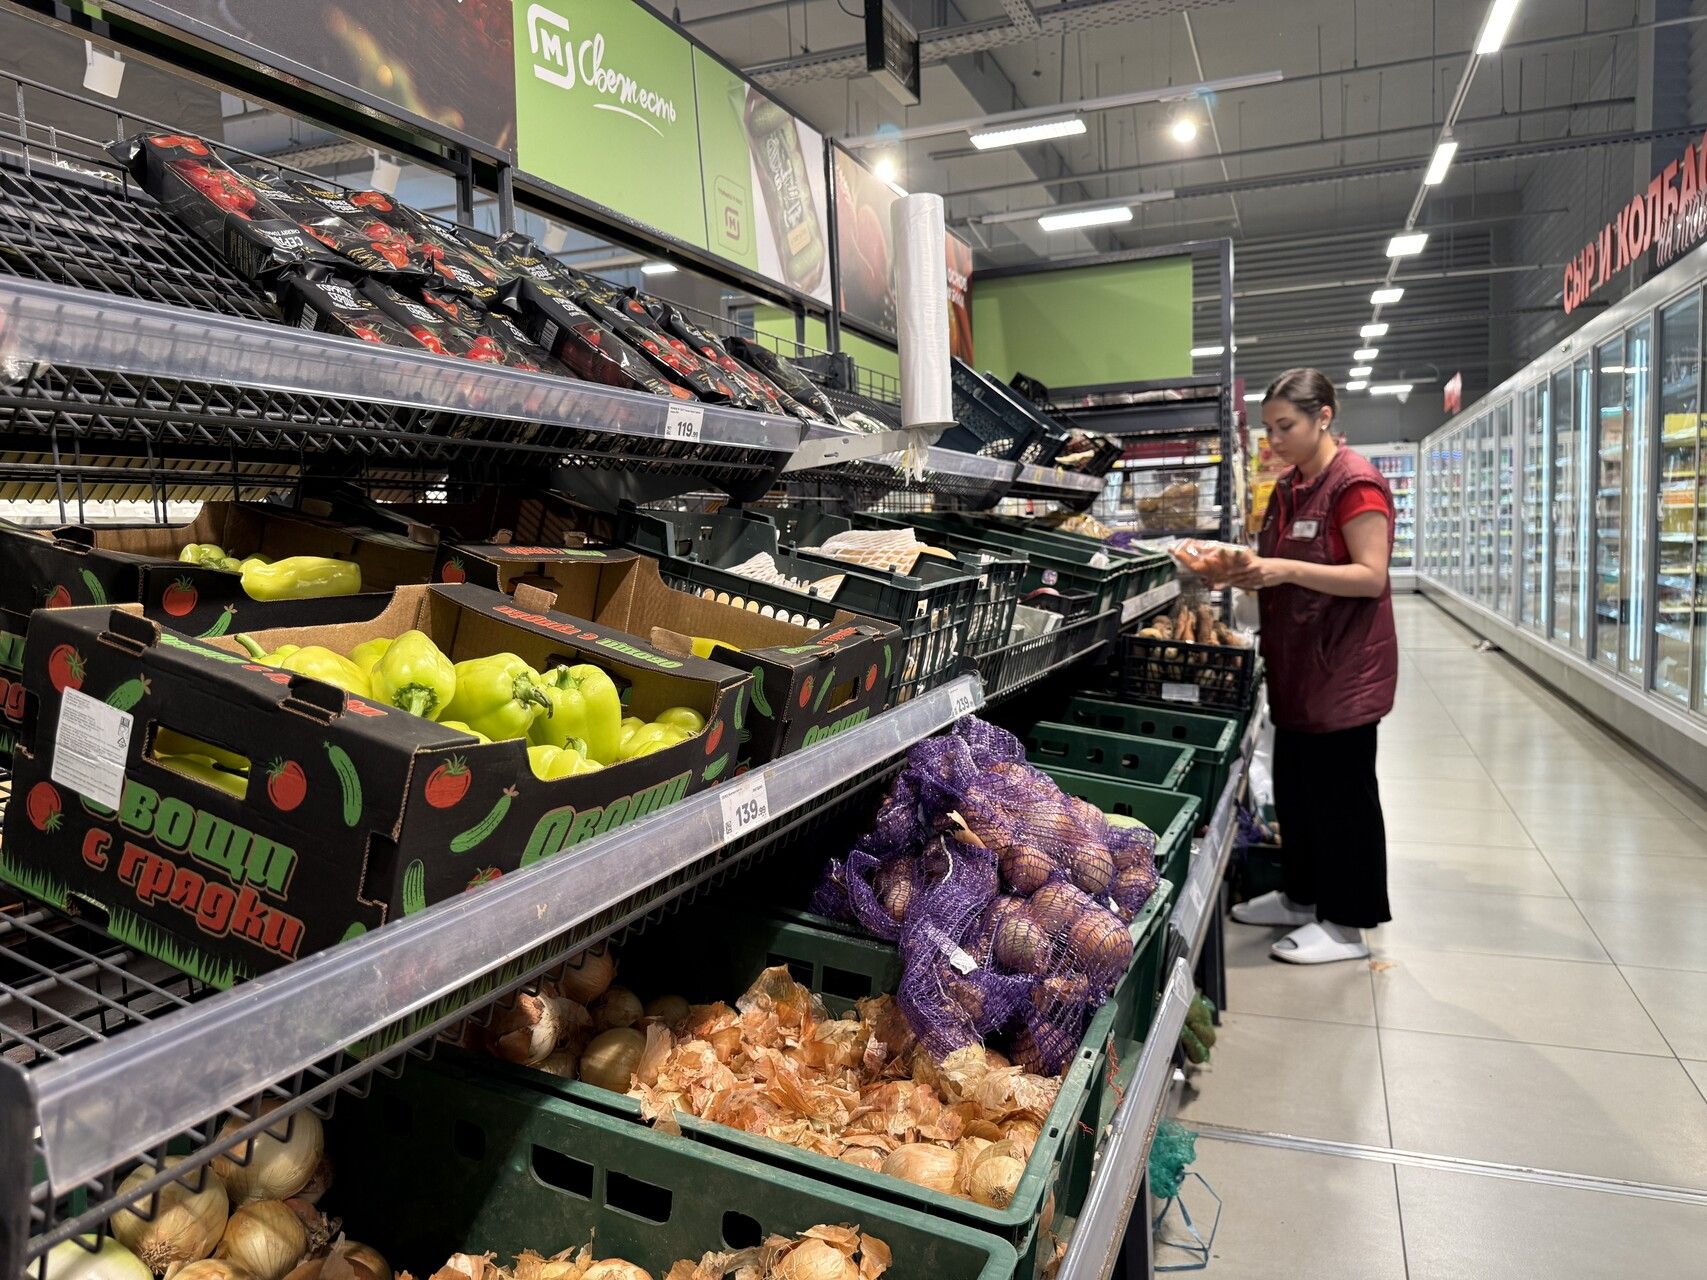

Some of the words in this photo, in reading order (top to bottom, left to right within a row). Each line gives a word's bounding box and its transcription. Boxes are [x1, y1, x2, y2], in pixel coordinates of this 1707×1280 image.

[578, 33, 677, 126] Свежесть
[1563, 242, 1597, 315] СЫР
[1598, 223, 1614, 287] И
[118, 843, 305, 961] грядки
